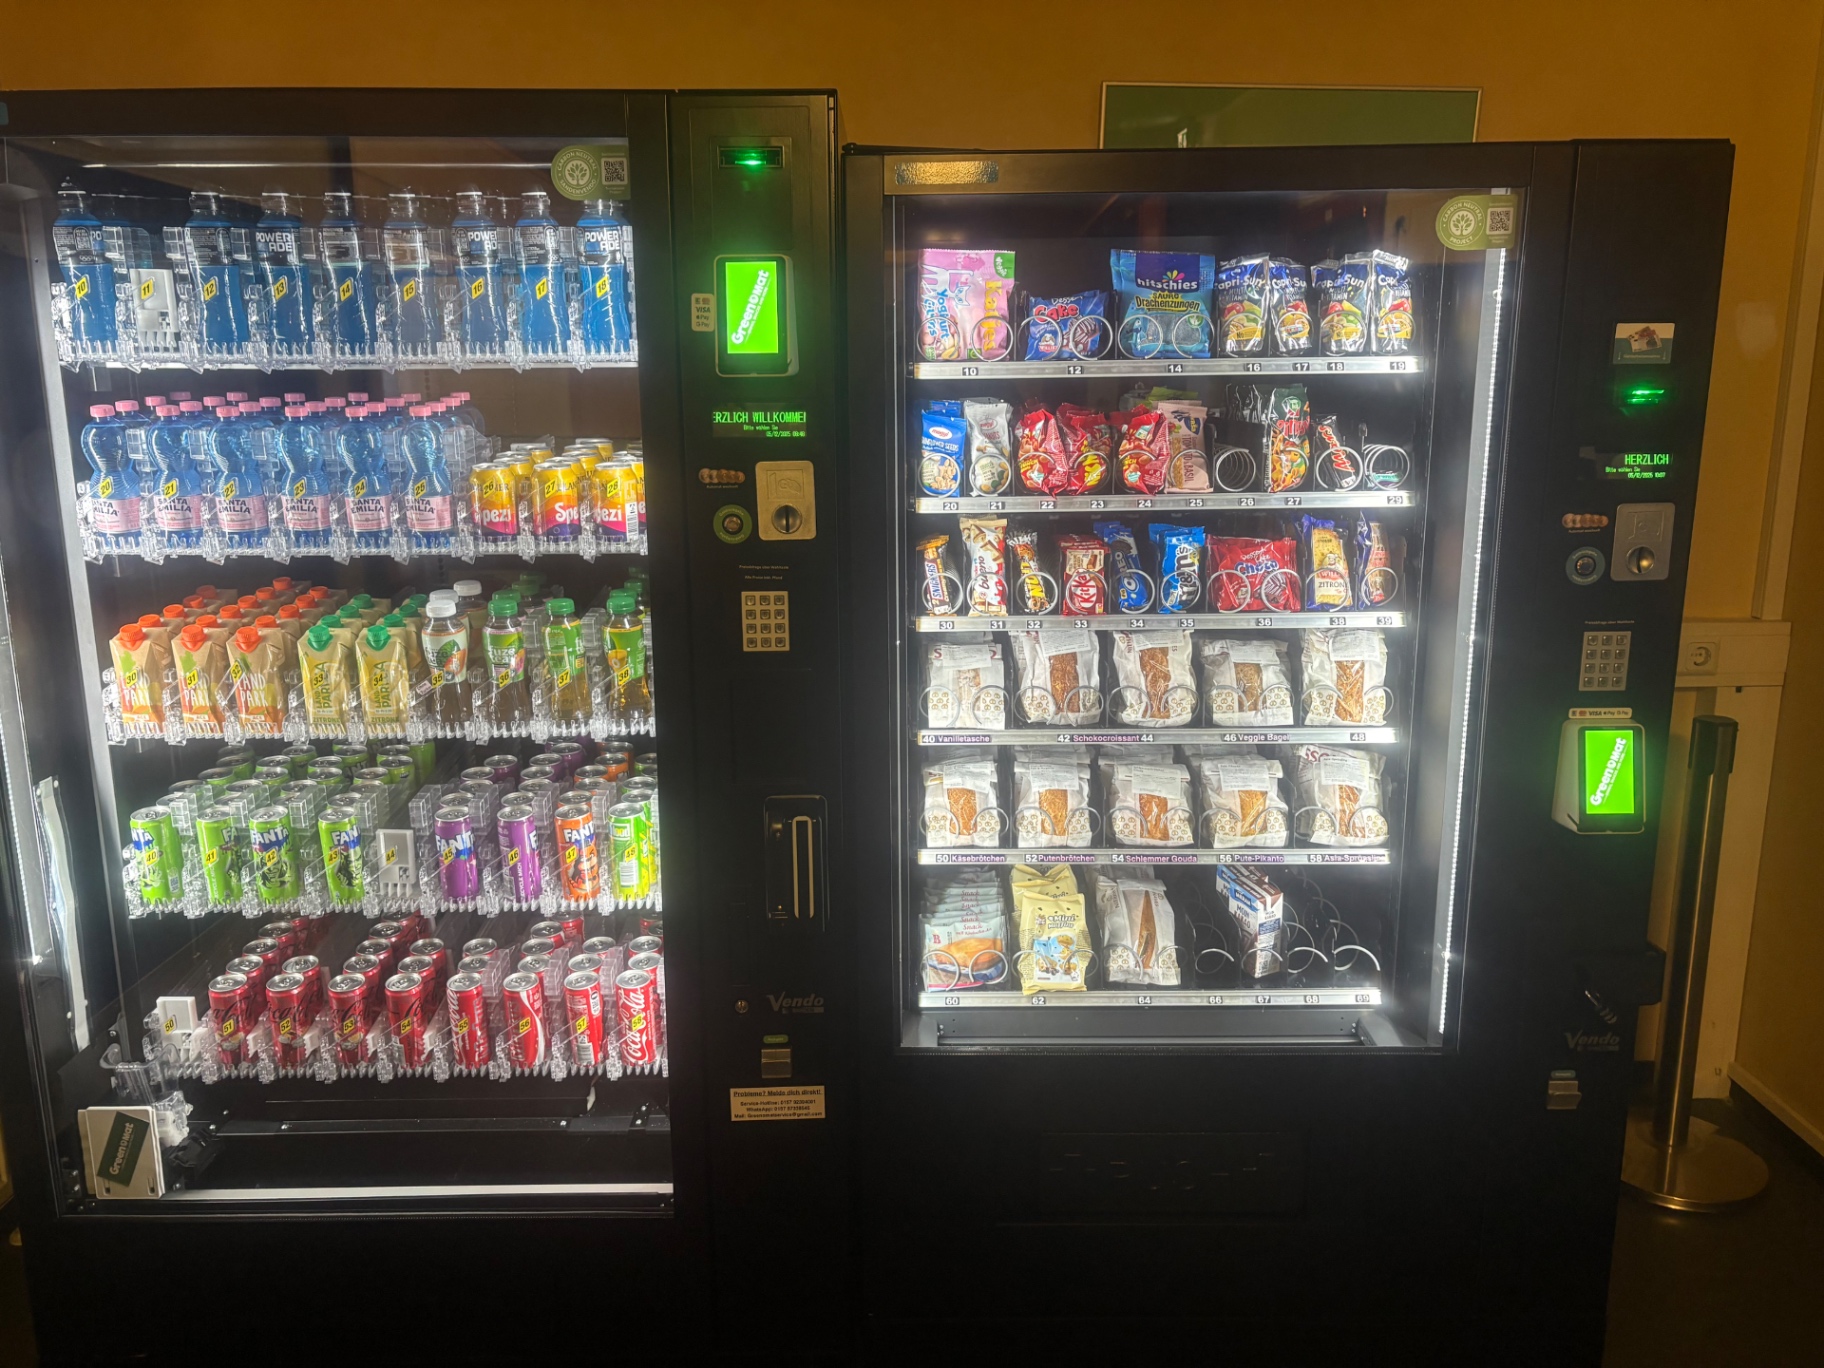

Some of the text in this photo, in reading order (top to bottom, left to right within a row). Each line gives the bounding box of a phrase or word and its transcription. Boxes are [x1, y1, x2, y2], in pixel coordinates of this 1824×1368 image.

[558, 151, 597, 171] CARBON NEUTRAL
[1443, 202, 1482, 222] CARBON NEUTRAL
[256, 232, 292, 242] POWER
[585, 232, 619, 242] POWER
[1450, 236, 1473, 244] PROJECT
[269, 242, 293, 252] ADE
[600, 241, 619, 250] ADE
[77, 282, 87, 295] 10
[275, 282, 286, 296] 13
[473, 281, 483, 295] 16
[537, 283, 547, 296] 17
[597, 280, 608, 293] 18
[1138, 278, 1198, 290] hitschies
[143, 286, 151, 297] 11
[204, 284, 215, 297] 12
[341, 285, 351, 298] 14
[404, 284, 415, 297] 15
[1136, 297, 1200, 311] Drachenzungen
[983, 279, 1002, 352] Katjes
[1035, 304, 1079, 323] Cake
[964, 367, 977, 376] 10
[1068, 366, 1082, 375] 12
[1169, 364, 1182, 373] 14
[1247, 363, 1261, 372] 16
[1295, 363, 1308, 372] 17
[1330, 362, 1344, 371] 18
[1391, 362, 1406, 371] 19
[1625, 454, 1669, 466] HERZLICH
[1184, 464, 1194, 482] BASIL
[101, 482, 111, 495] 20
[165, 484, 175, 495] 21
[225, 484, 235, 496] 22
[294, 483, 305, 495] 23
[355, 482, 365, 495] 24
[415, 482, 425, 495] 25
[483, 481, 494, 494] 26
[545, 481, 555, 494] 27
[607, 481, 618, 494] 28
[158, 498, 187, 506] SANTA
[352, 498, 381, 506] SANTA
[944, 502, 958, 510] 20
[990, 502, 1001, 510] 21
[1041, 501, 1054, 509] 22
[1091, 501, 1104, 509] 23
[1139, 500, 1151, 508] 24
[1189, 499, 1203, 507] 25
[1241, 498, 1254, 506] 26
[1388, 497, 1402, 505] 29
[158, 504, 192, 513] EMILIA
[351, 505, 384, 513] EMILIA
[1234, 559, 1279, 576] Choco
[1020, 560, 1046, 598] LION
[991, 621, 1003, 629] 31
[1075, 620, 1088, 628] 33
[1181, 619, 1194, 627] 35
[1258, 618, 1271, 626] 36
[1332, 617, 1345, 625] 38
[1379, 617, 1392, 625] 39
[127, 673, 137, 685] 30
[187, 673, 196, 685] 31
[313, 673, 324, 686] 33
[373, 673, 383, 686] 34
[432, 673, 443, 686] 35
[500, 671, 510, 683] 36
[559, 671, 570, 684] 37
[618, 670, 630, 682] 38
[184, 690, 212, 706] PARK
[241, 690, 268, 706] PARK
[923, 735, 990, 743] 40 Vanilletasche
[1058, 734, 1140, 743] 42 Schokocroissant
[1141, 734, 1154, 742] 44
[1224, 733, 1290, 743] 46 Veggie Bagel
[1352, 733, 1365, 741] 48
[251, 826, 289, 845] FANTA
[146, 853, 157, 863] 40
[206, 851, 216, 862] 41
[267, 851, 276, 863] 42
[328, 851, 338, 862] 43
[386, 850, 396, 862] 44
[443, 850, 453, 861] 45
[509, 851, 519, 862] 46
[566, 848, 576, 859] 47
[626, 847, 636, 858] 48
[1220, 854, 1232, 862] 56
[1310, 854, 1322, 862] 58
[937, 854, 1005, 863] 50 Käsebrötchen
[1026, 854, 1095, 863] 52 Putenbrötchen
[1112, 854, 1197, 863] 54 Schlemmer Gouda
[1236, 903, 1250, 918] MOIN
[963, 922, 983, 931] Snack
[766, 991, 824, 1011] Vendo
[1138, 996, 1150, 1004] 64
[165, 1020, 174, 1032] 50
[281, 1021, 291, 1032] 52
[344, 1021, 354, 1032] 53
[401, 1021, 411, 1032] 54
[459, 1020, 468, 1031] 55
[520, 1019, 530, 1030] 56
[576, 1020, 586, 1031] 57
[632, 1016, 642, 1028] 58
[224, 1023, 233, 1034] 51
[1564, 1029, 1620, 1049] Vendo
